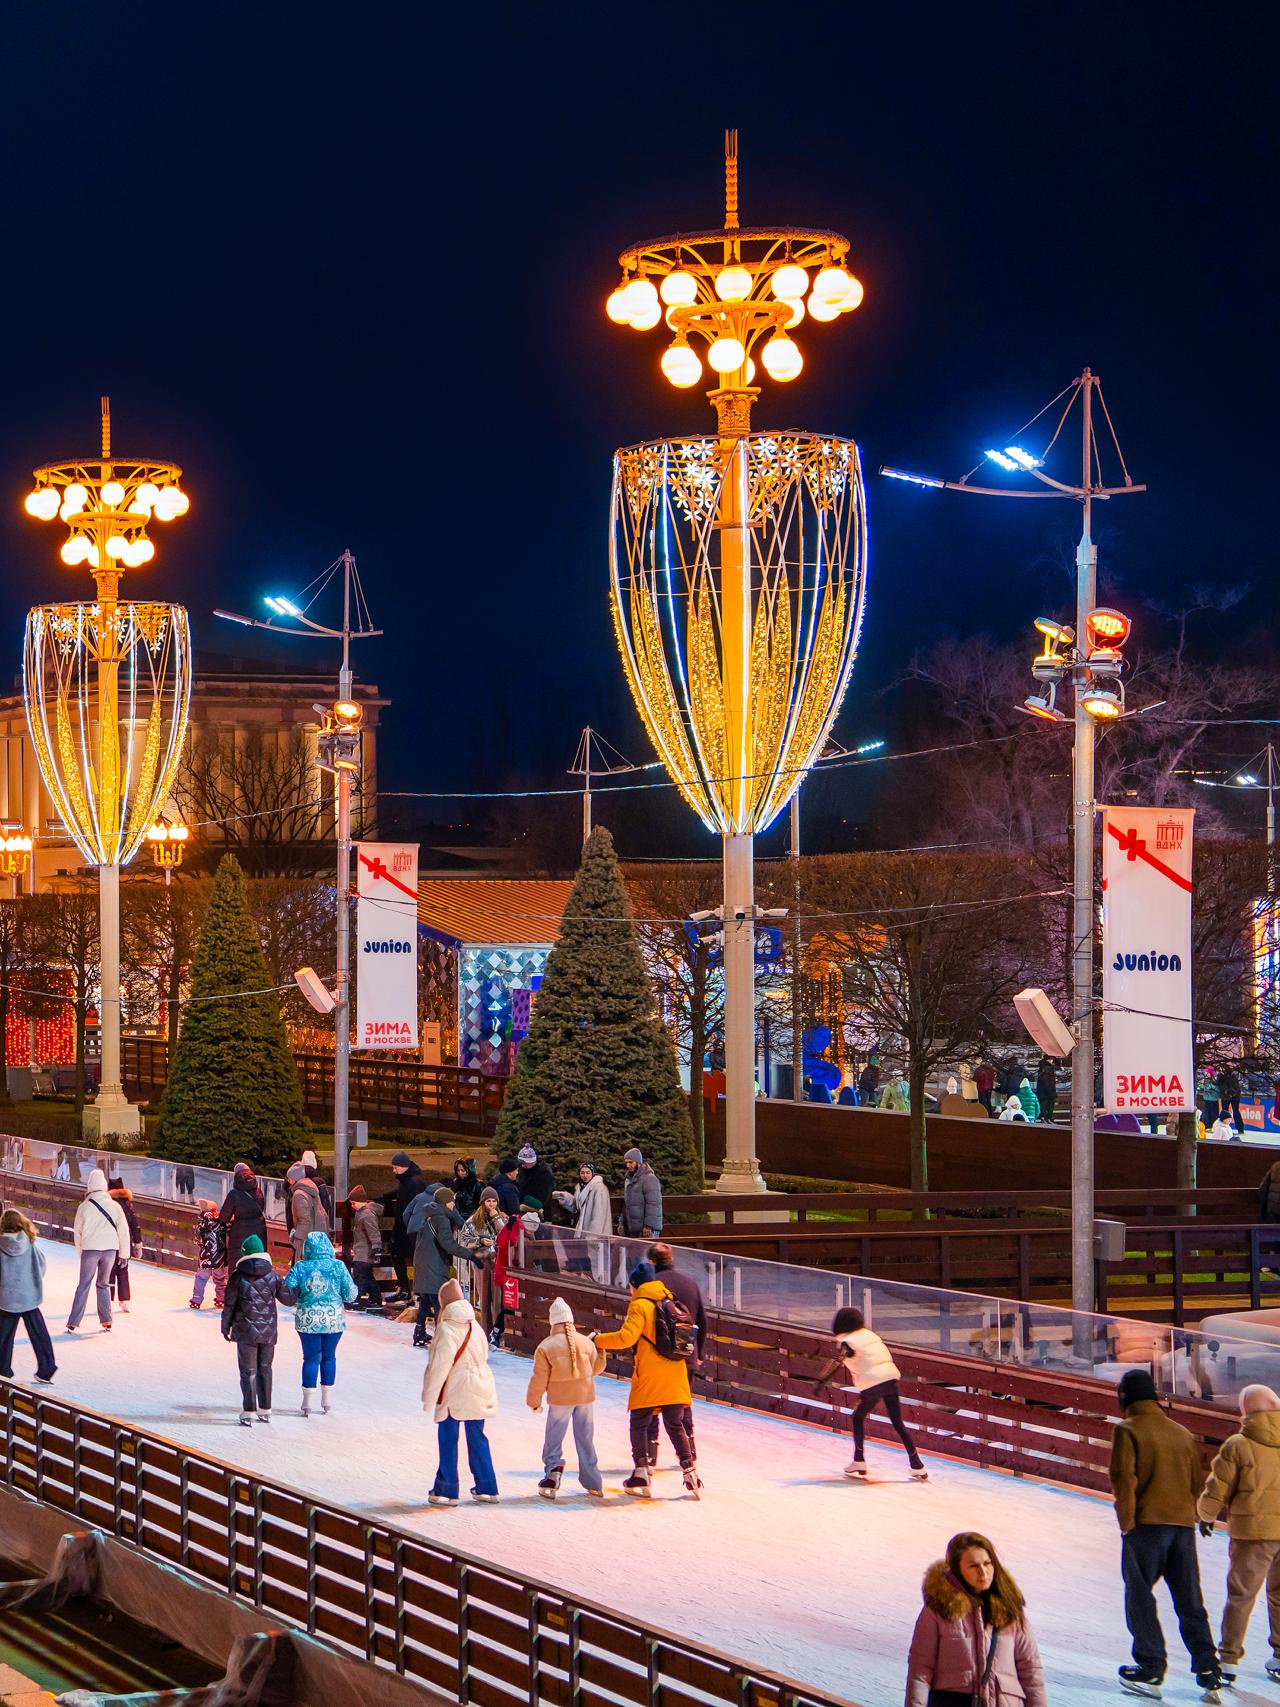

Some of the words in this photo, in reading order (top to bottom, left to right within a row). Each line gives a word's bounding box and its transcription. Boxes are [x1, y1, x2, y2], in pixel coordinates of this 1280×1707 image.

[1156, 841, 1183, 850] ВДНХ
[363, 939, 412, 954] Junion
[1112, 950, 1182, 972] Junion
[365, 1022, 412, 1035] ЗИМА
[1116, 1075, 1185, 1094] ЗИМА
[1116, 1096, 1125, 1107] В
[1129, 1096, 1186, 1107] МОСКВЕ
